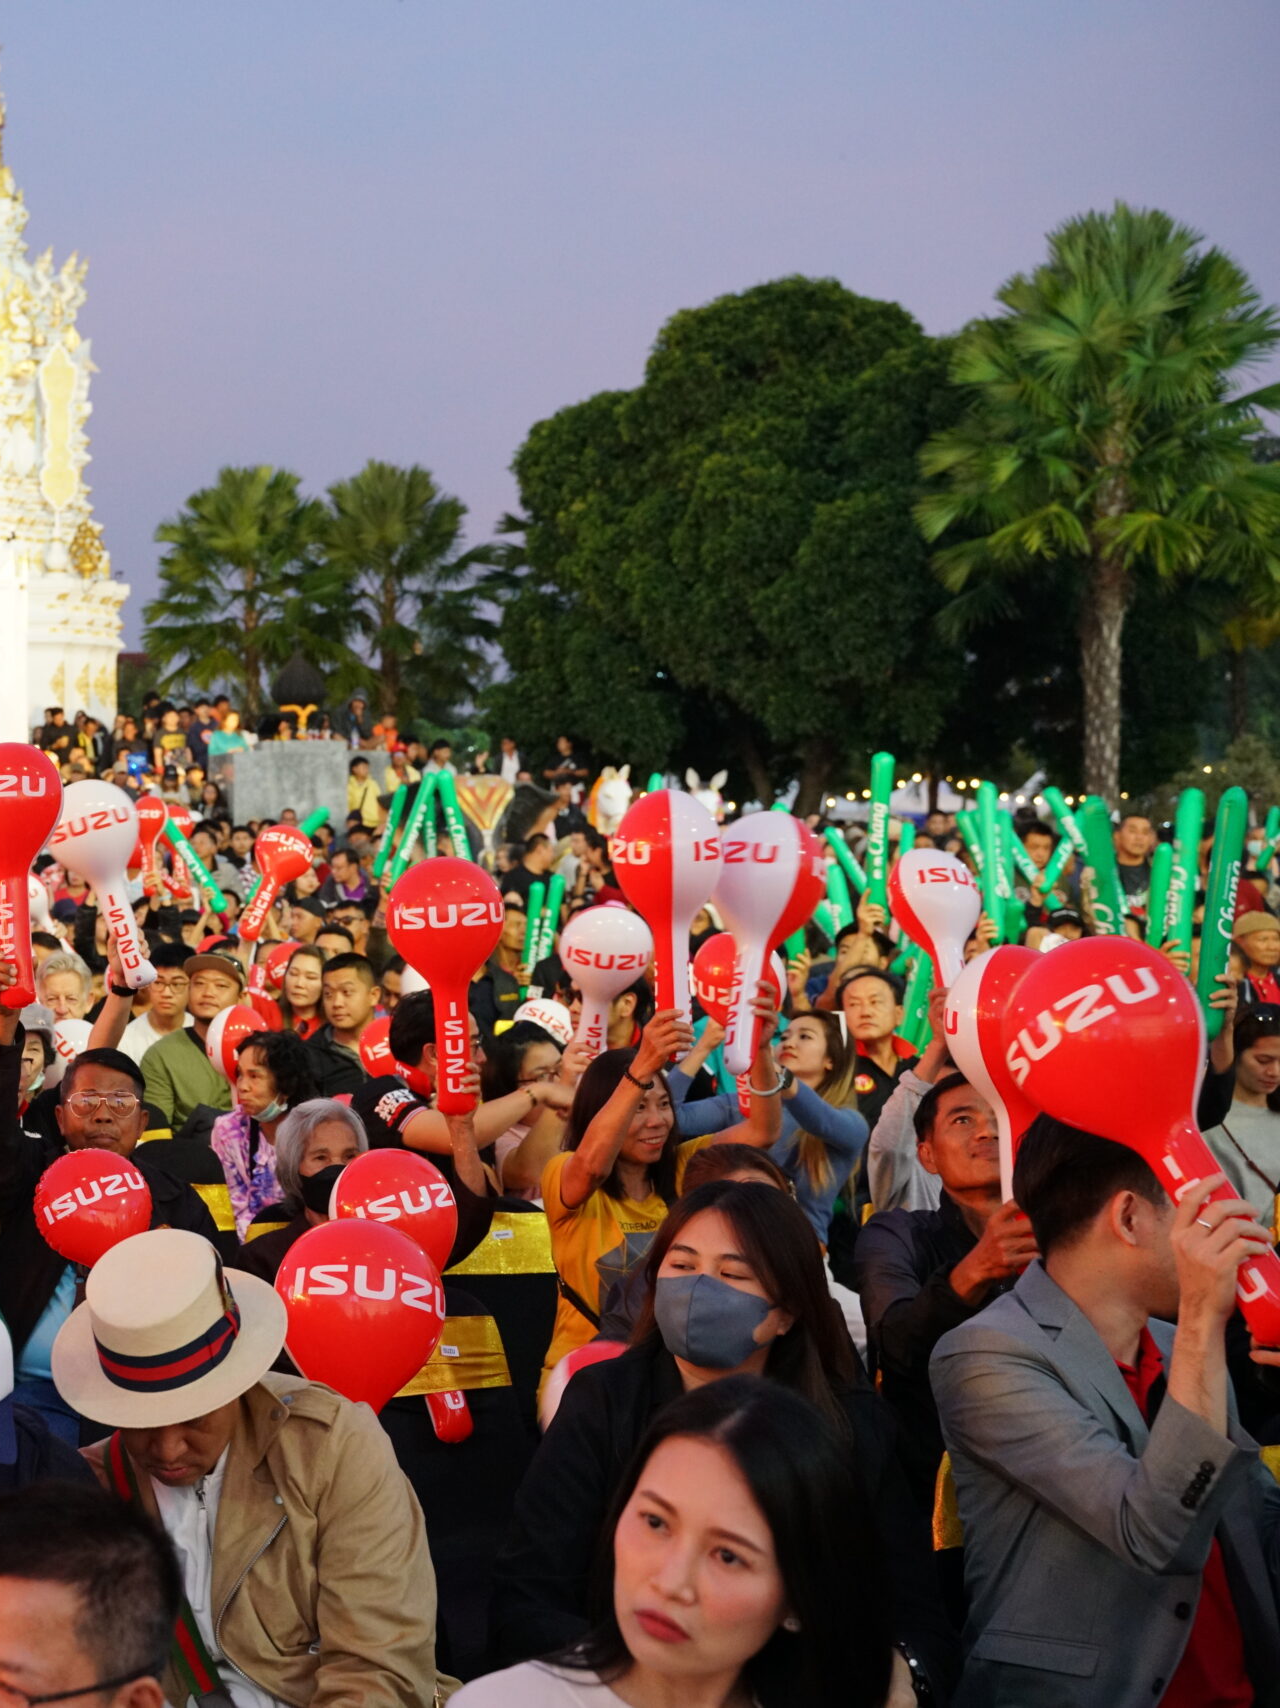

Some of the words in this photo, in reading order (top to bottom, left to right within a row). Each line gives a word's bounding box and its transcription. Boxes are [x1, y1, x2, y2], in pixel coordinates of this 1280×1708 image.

[261, 832, 314, 863] ISUZU
[108, 894, 140, 970] ISUZU
[393, 902, 505, 930] ISUZU
[567, 946, 651, 971] ISUZU
[443, 1002, 465, 1094] ISUZU
[43, 1171, 146, 1226] ISUZU
